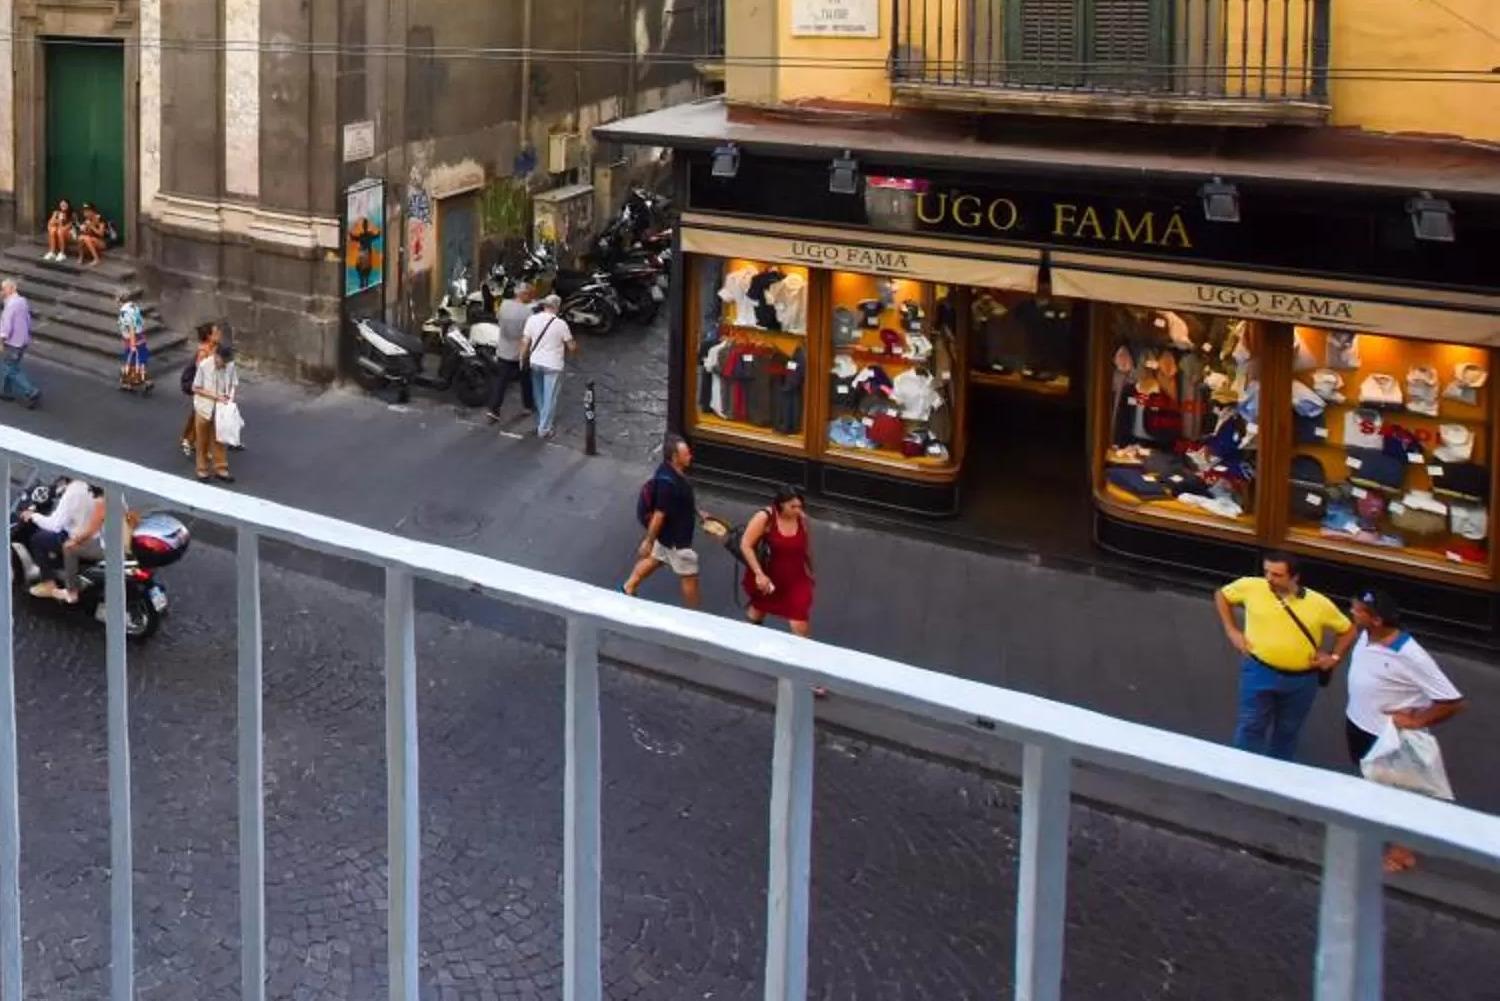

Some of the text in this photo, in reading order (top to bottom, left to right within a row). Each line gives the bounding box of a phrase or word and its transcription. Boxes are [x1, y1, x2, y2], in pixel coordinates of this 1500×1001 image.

[915, 191, 1019, 231] UGO
[791, 242, 839, 260] UGO
[1196, 286, 1260, 308] UGO
